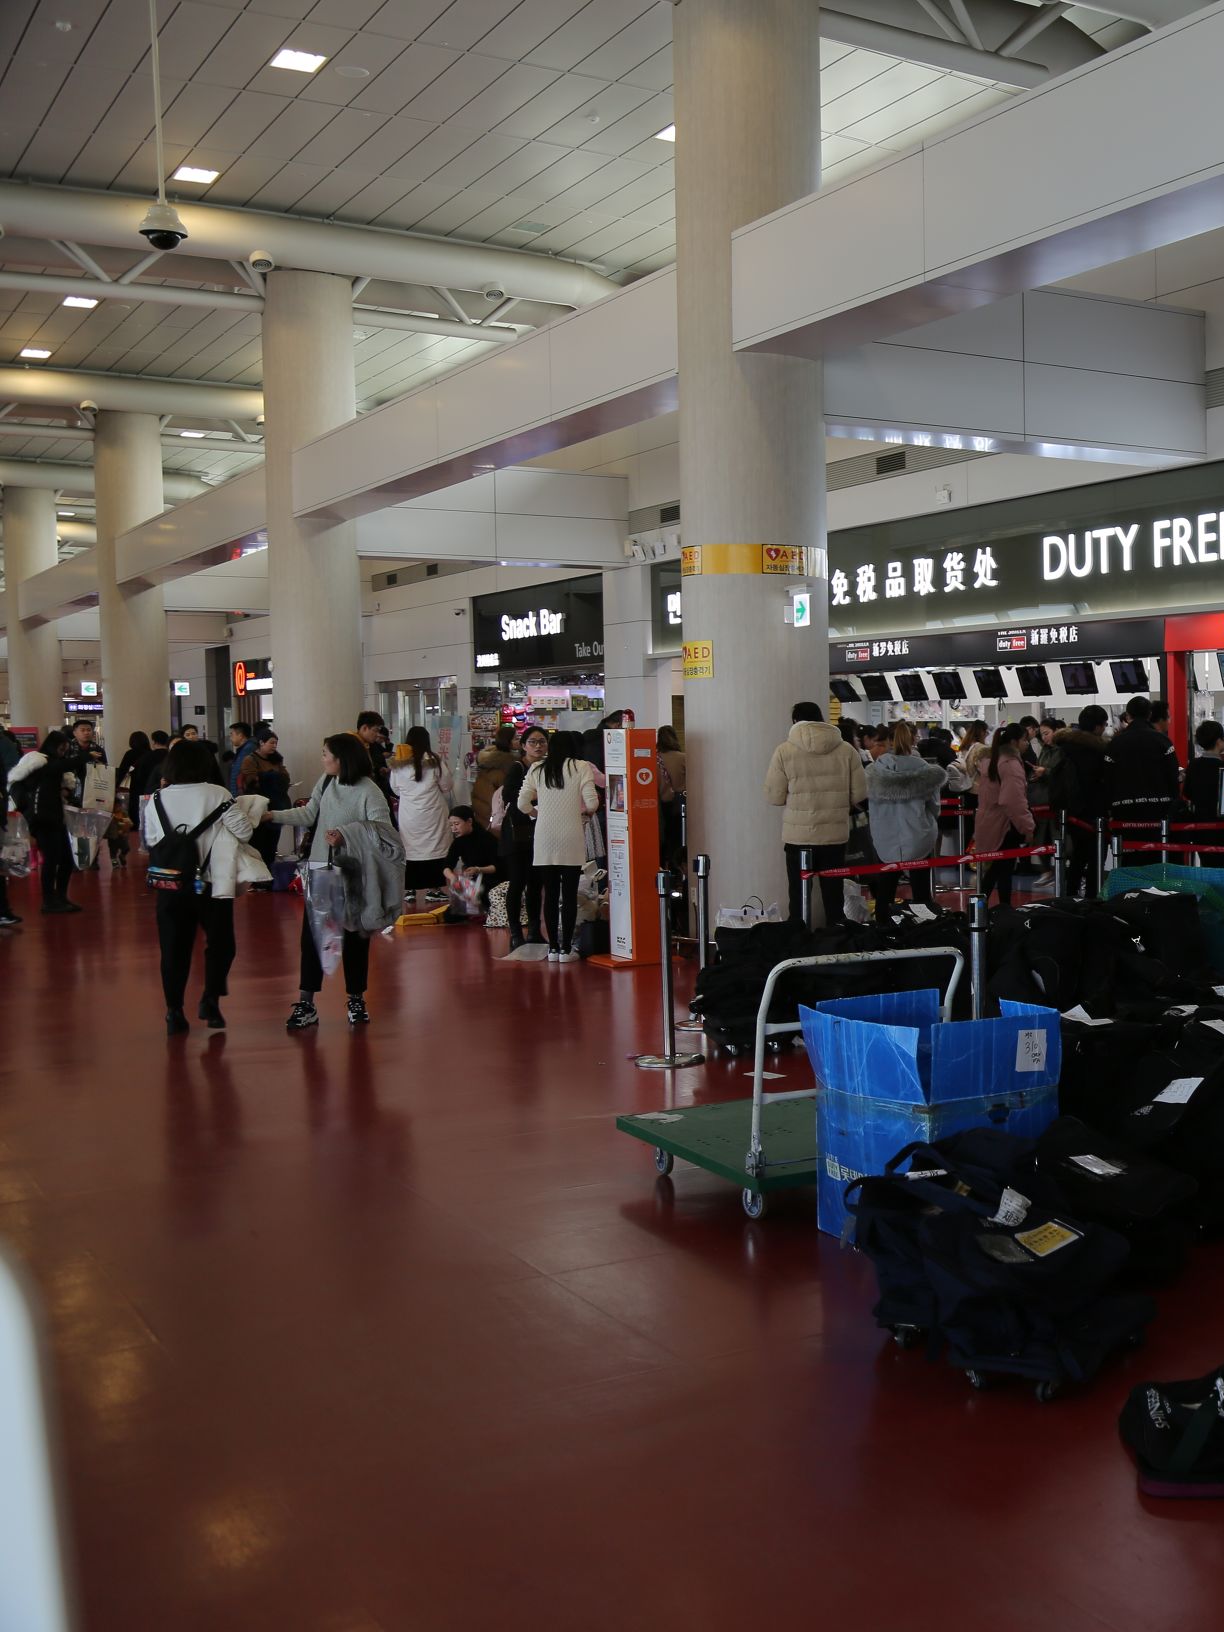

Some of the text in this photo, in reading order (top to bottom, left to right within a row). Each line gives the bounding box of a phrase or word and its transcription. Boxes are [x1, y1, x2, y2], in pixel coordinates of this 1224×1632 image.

[1042, 524, 1140, 581] DUTY
[831, 547, 999, 606] 免税品取货处
[501, 608, 564, 641] Snack Bar
[574, 643, 591, 657] Take
[687, 647, 711, 659] AED
[1012, 638, 1025, 647] free
